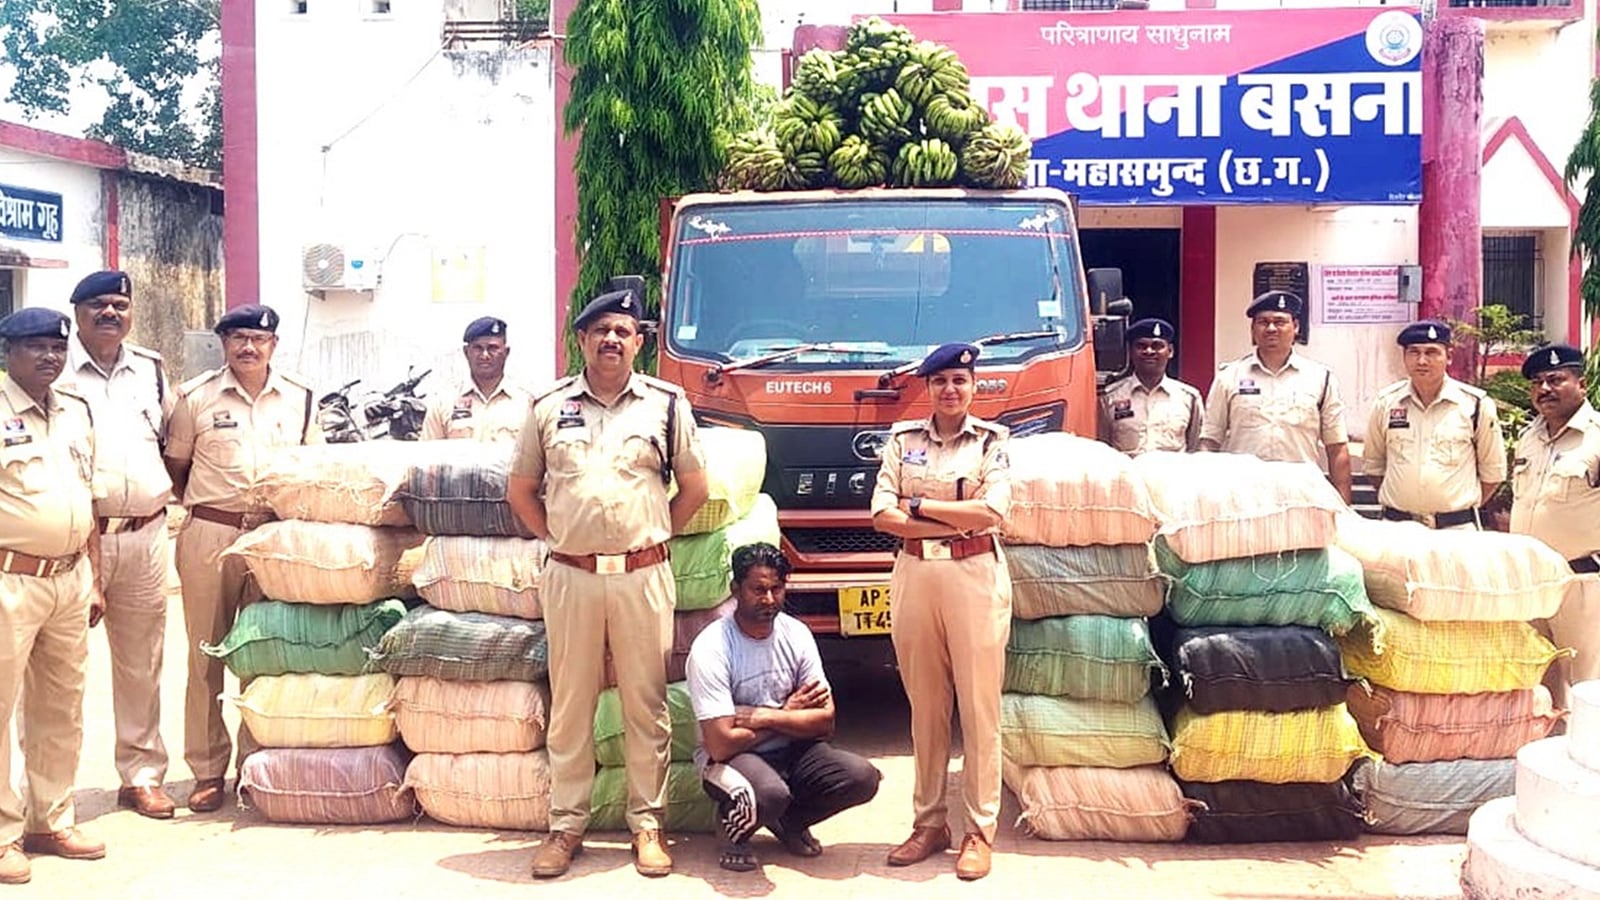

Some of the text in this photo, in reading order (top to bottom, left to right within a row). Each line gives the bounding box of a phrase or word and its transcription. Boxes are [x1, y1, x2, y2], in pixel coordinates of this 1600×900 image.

[1039, 20, 1232, 50] परित्राणाय साधुनाम
[1066, 72, 1228, 139] थाना
[1238, 71, 1422, 137] बसना
[1218, 148, 1330, 193] (छ.ग.)
[860, 589, 880, 607] AP
